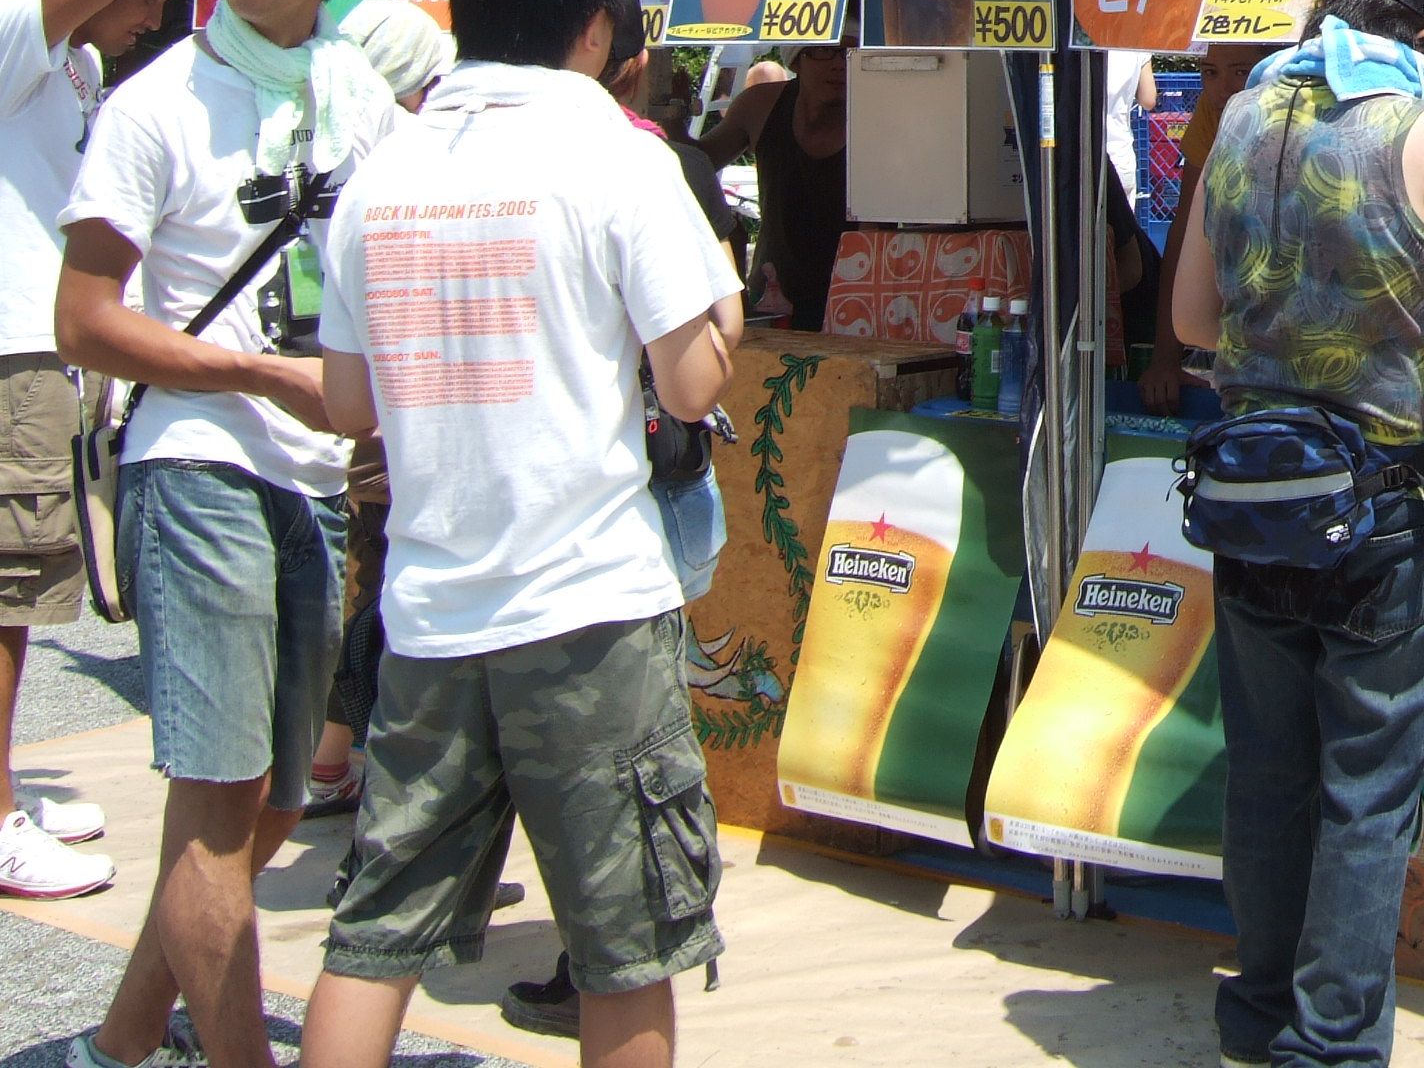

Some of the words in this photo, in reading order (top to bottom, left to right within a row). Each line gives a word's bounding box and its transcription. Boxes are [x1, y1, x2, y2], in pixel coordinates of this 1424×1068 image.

[763, 0, 832, 37] ¥600
[975, 4, 1047, 44] ¥500
[1199, 14, 1293, 35] 2色カレー
[364, 205, 402, 223] ROCK
[404, 205, 418, 221] IN
[418, 203, 466, 220] JAPAN
[832, 552, 908, 584] Heineken
[1082, 583, 1174, 615] Heineken
